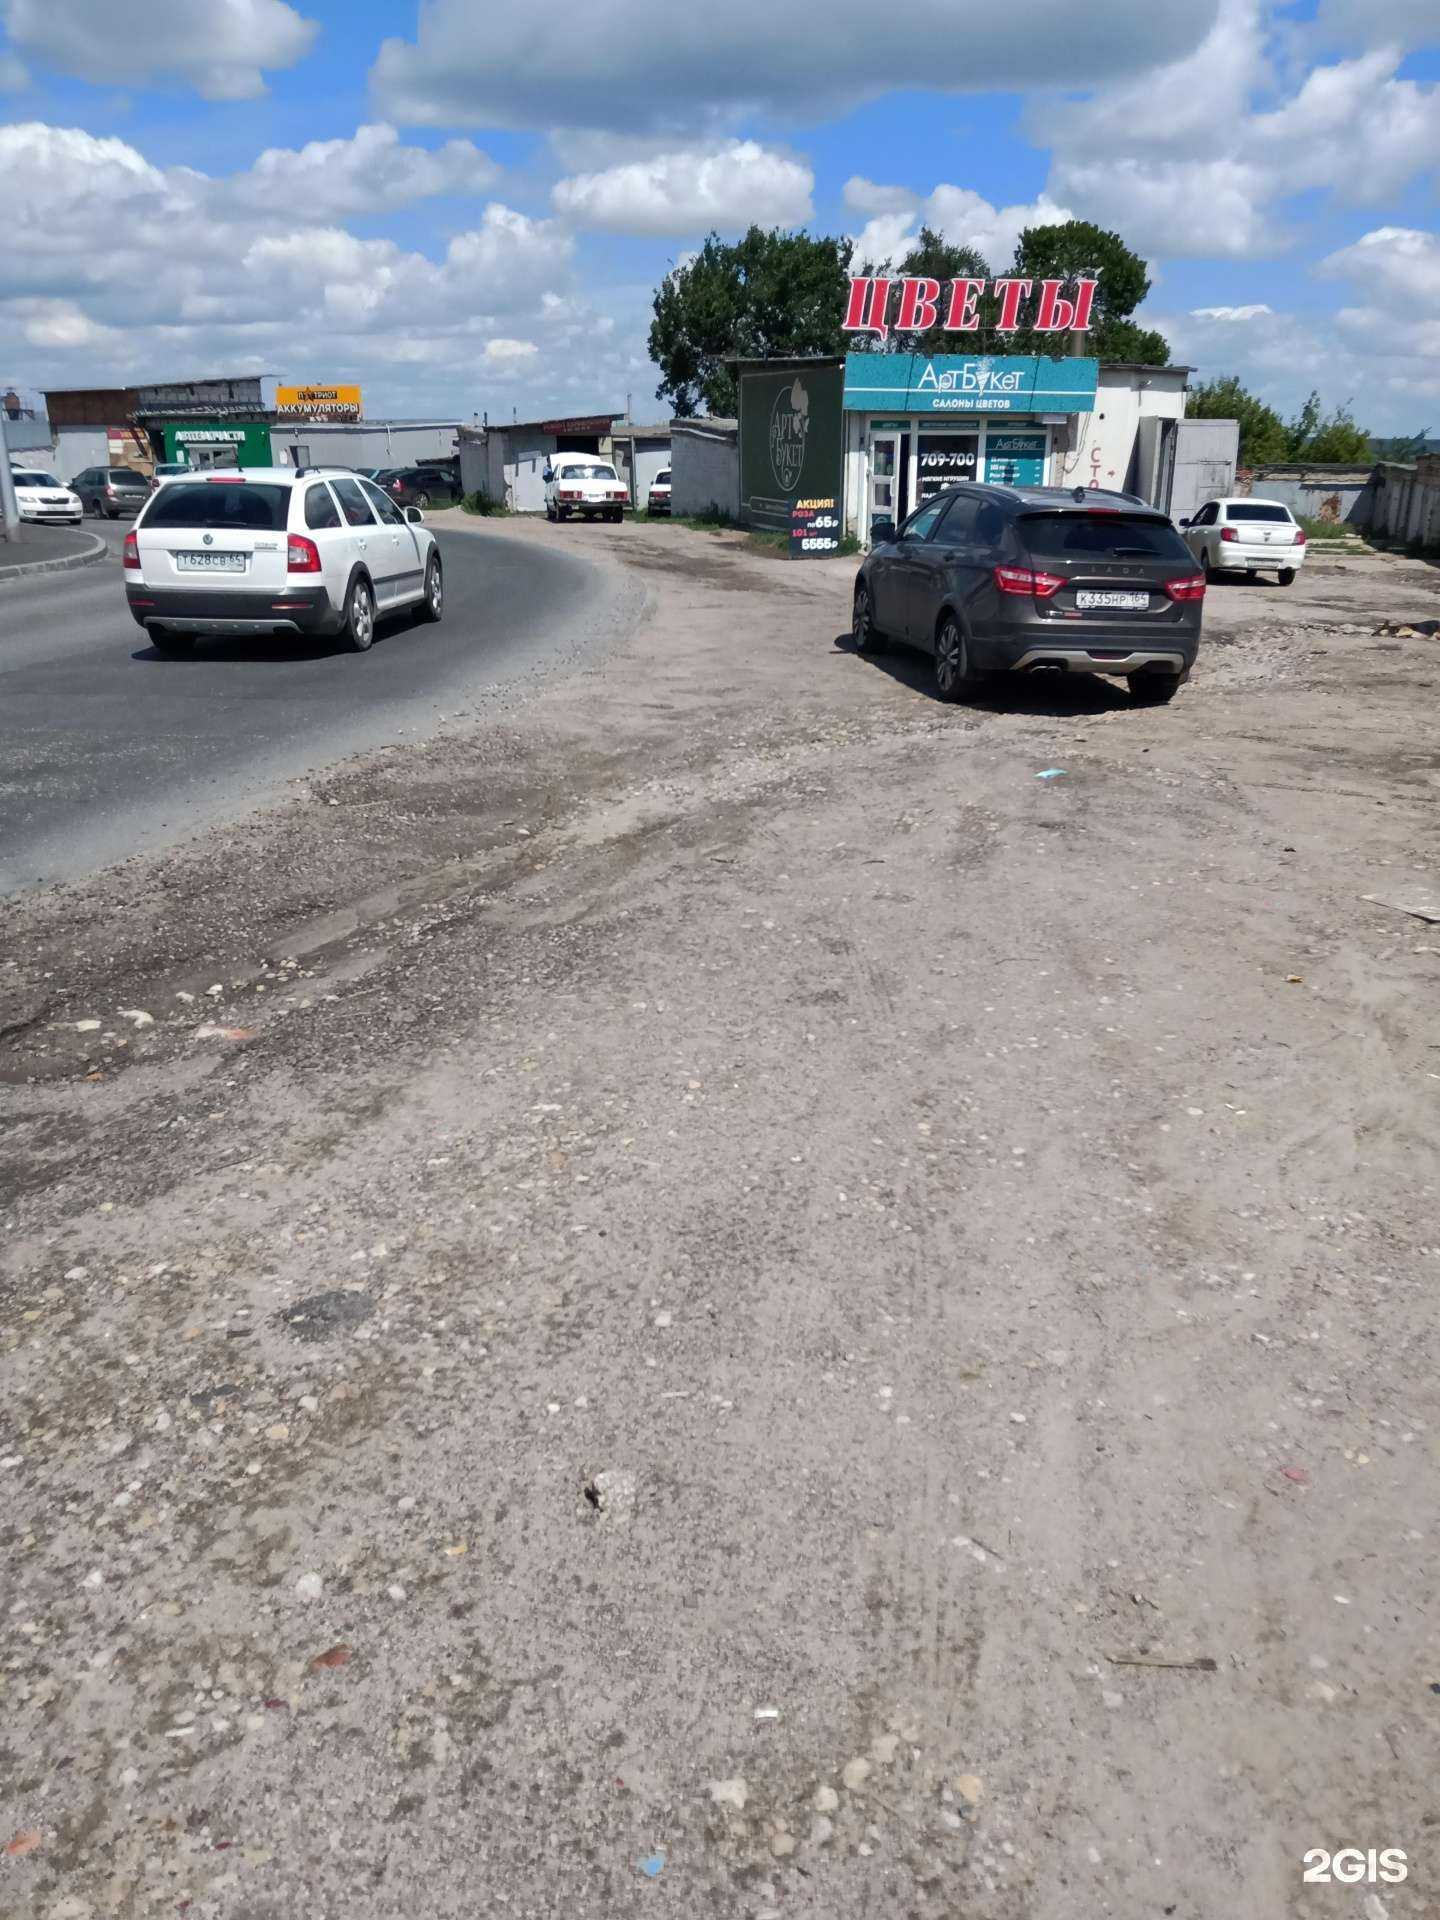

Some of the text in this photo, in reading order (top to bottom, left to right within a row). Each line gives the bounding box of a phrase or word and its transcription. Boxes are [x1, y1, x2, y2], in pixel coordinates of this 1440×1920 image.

[842, 277, 1099, 341] ЦВЕТЫ
[277, 403, 360, 414] АККУМУЛЯТОРЫ
[932, 399, 1010, 409] САЛОНЫ ЦВЕТОВ
[920, 453, 974, 467] 709-700
[796, 498, 834, 509] АКЦИЯ!
